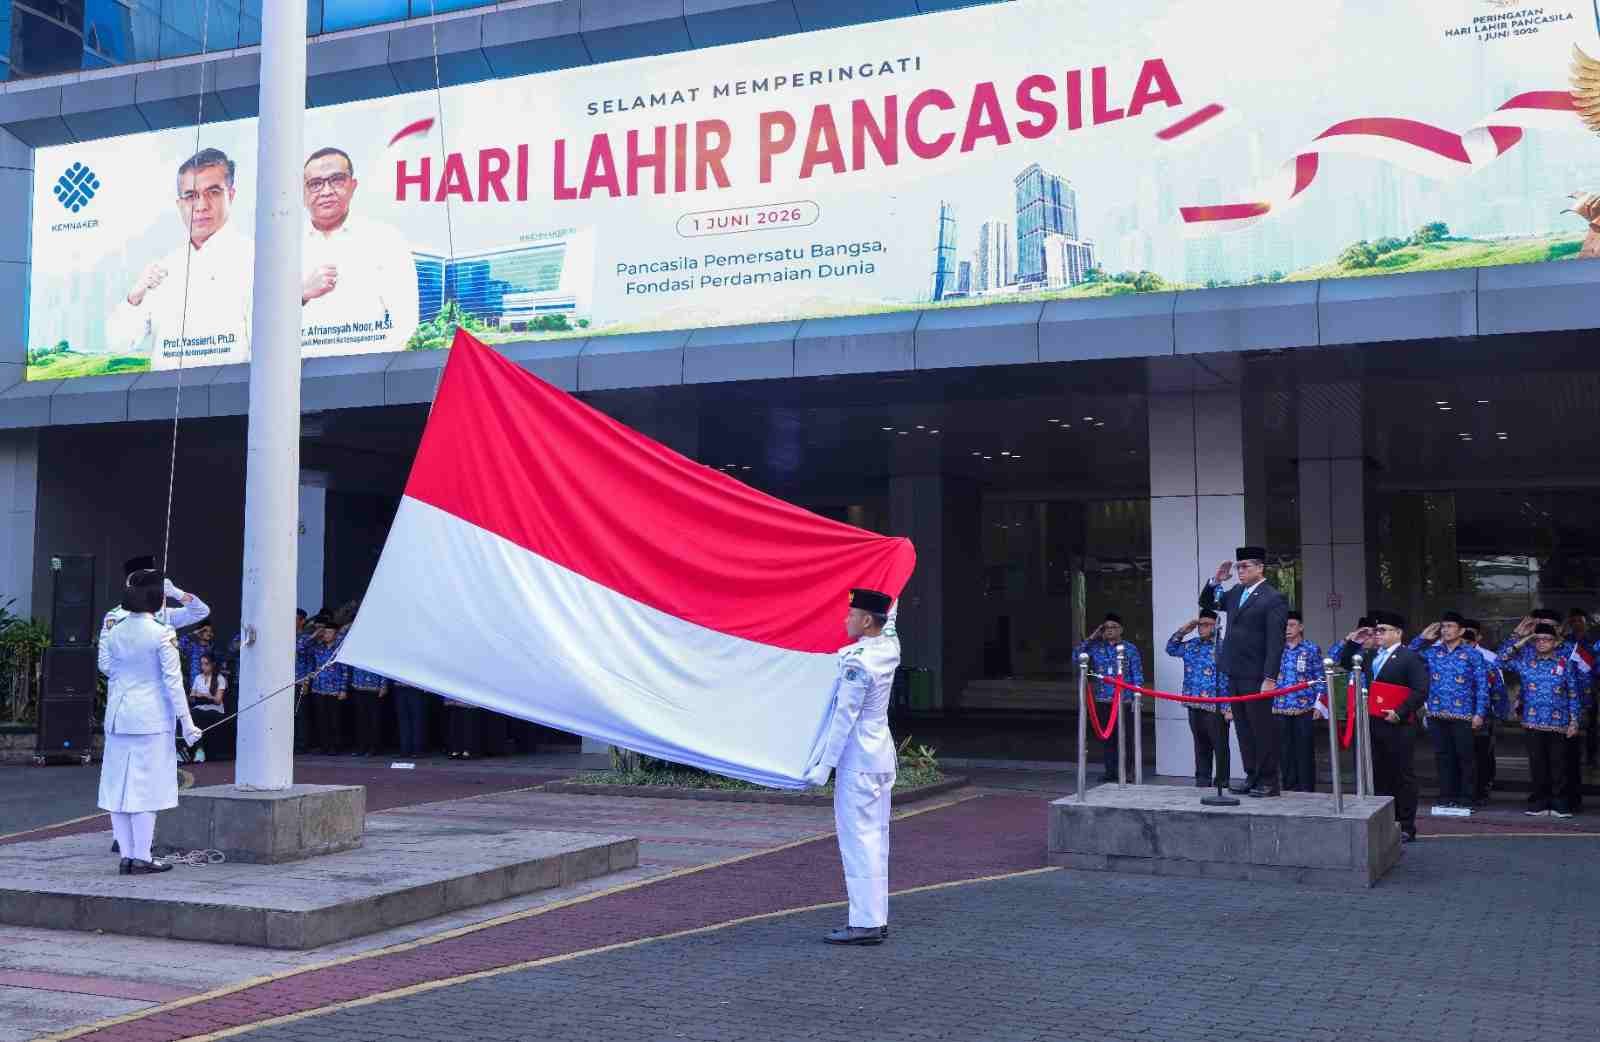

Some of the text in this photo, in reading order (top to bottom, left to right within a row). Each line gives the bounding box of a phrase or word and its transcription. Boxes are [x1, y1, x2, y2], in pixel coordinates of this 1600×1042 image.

[1445, 13, 1574, 37] HARI LAHIR PANCASILA
[1473, 8, 1543, 24] PERINGATAN
[1484, 31, 1509, 41] JUNI
[587, 56, 922, 116] SELAMAT MEMPERINGATI
[396, 58, 1183, 202] HARI LAHIR PANCASILA
[51, 219, 99, 231] KEMNAKER
[694, 208, 802, 231] 1 JUNI 2026
[616, 239, 887, 276] Pancasila Pemersatu Bangsa,
[626, 260, 875, 295] Fondasi Perdamaian Dunia
[307, 322, 351, 336] Afriansyah
